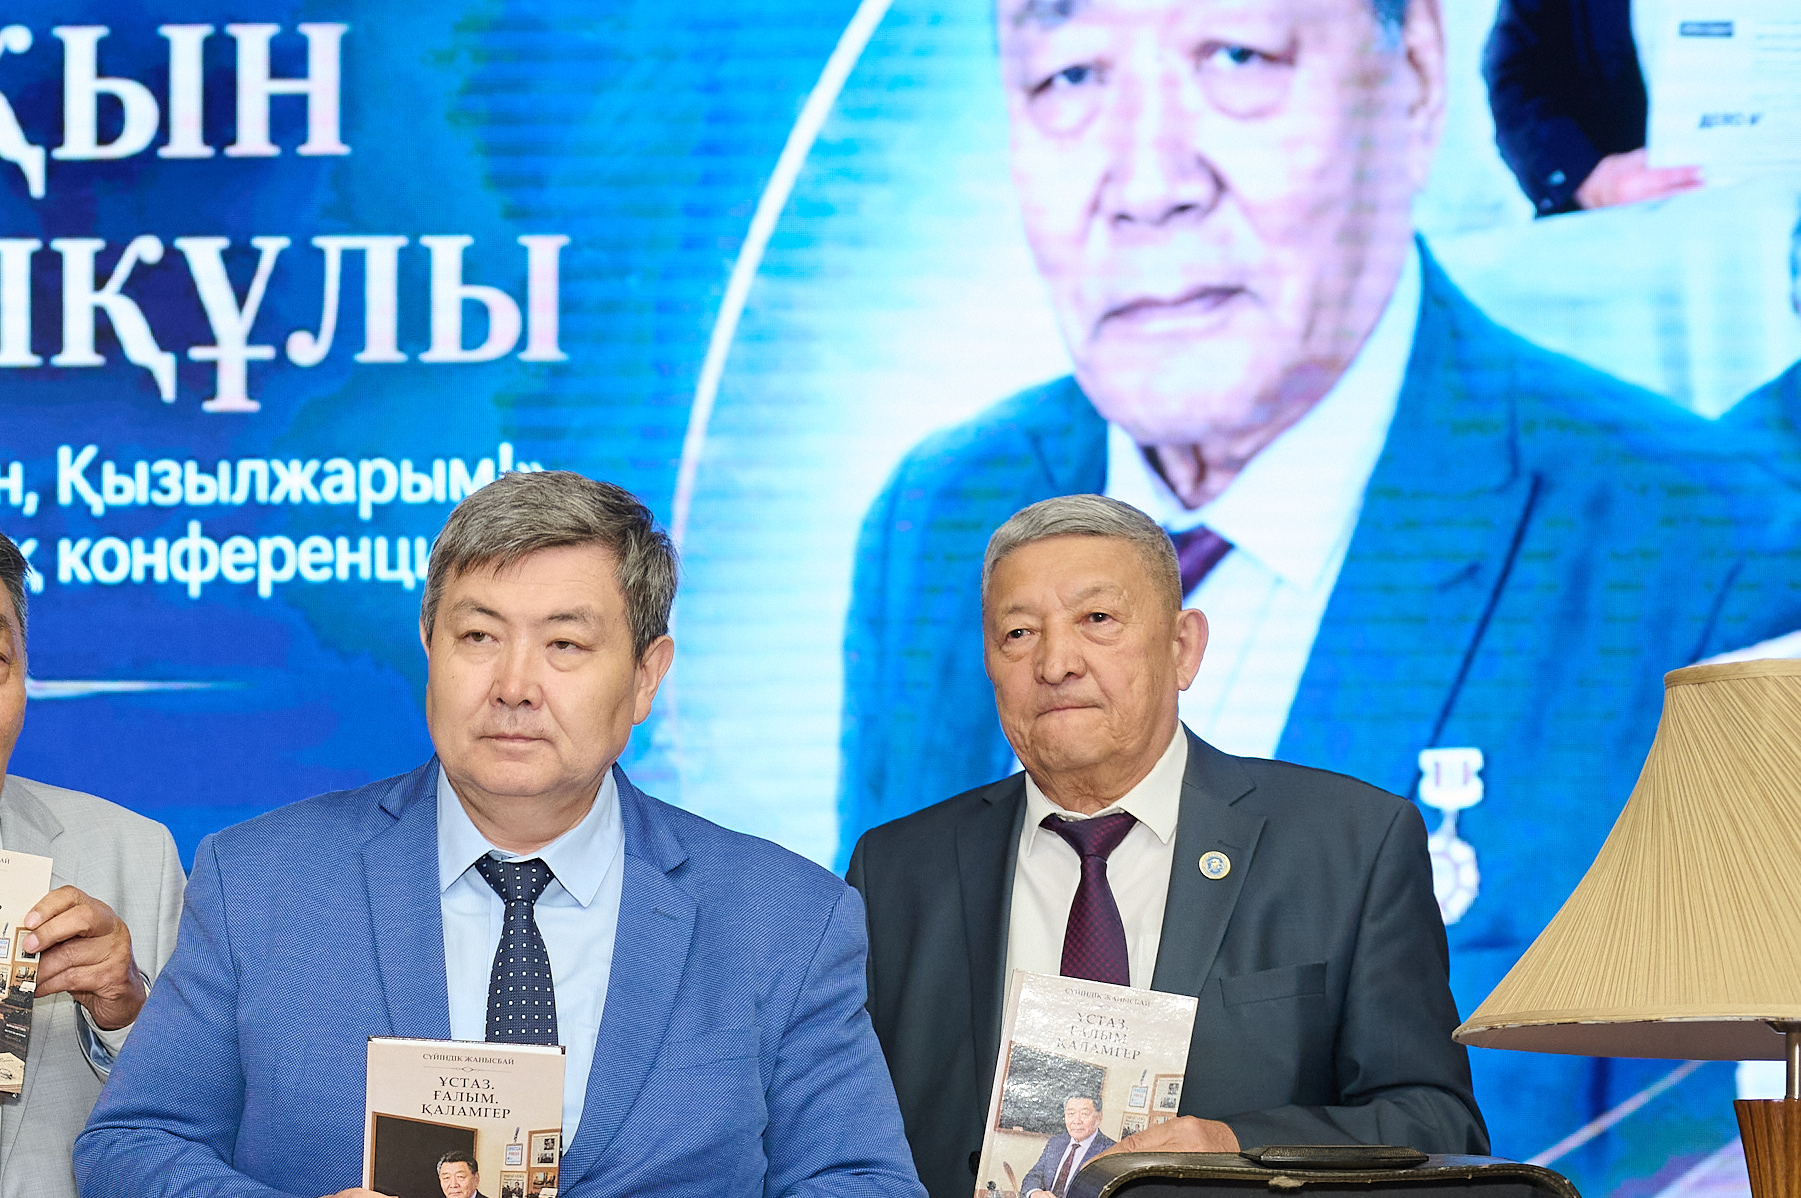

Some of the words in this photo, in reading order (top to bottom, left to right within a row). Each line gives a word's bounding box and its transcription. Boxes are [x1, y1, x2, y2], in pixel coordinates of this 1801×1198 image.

[438, 1076, 495, 1090] ҰСТАЗ.
[432, 1090, 499, 1105] ҒАЛЫМ.
[421, 1103, 511, 1119] ҚАЛАМГЕР
